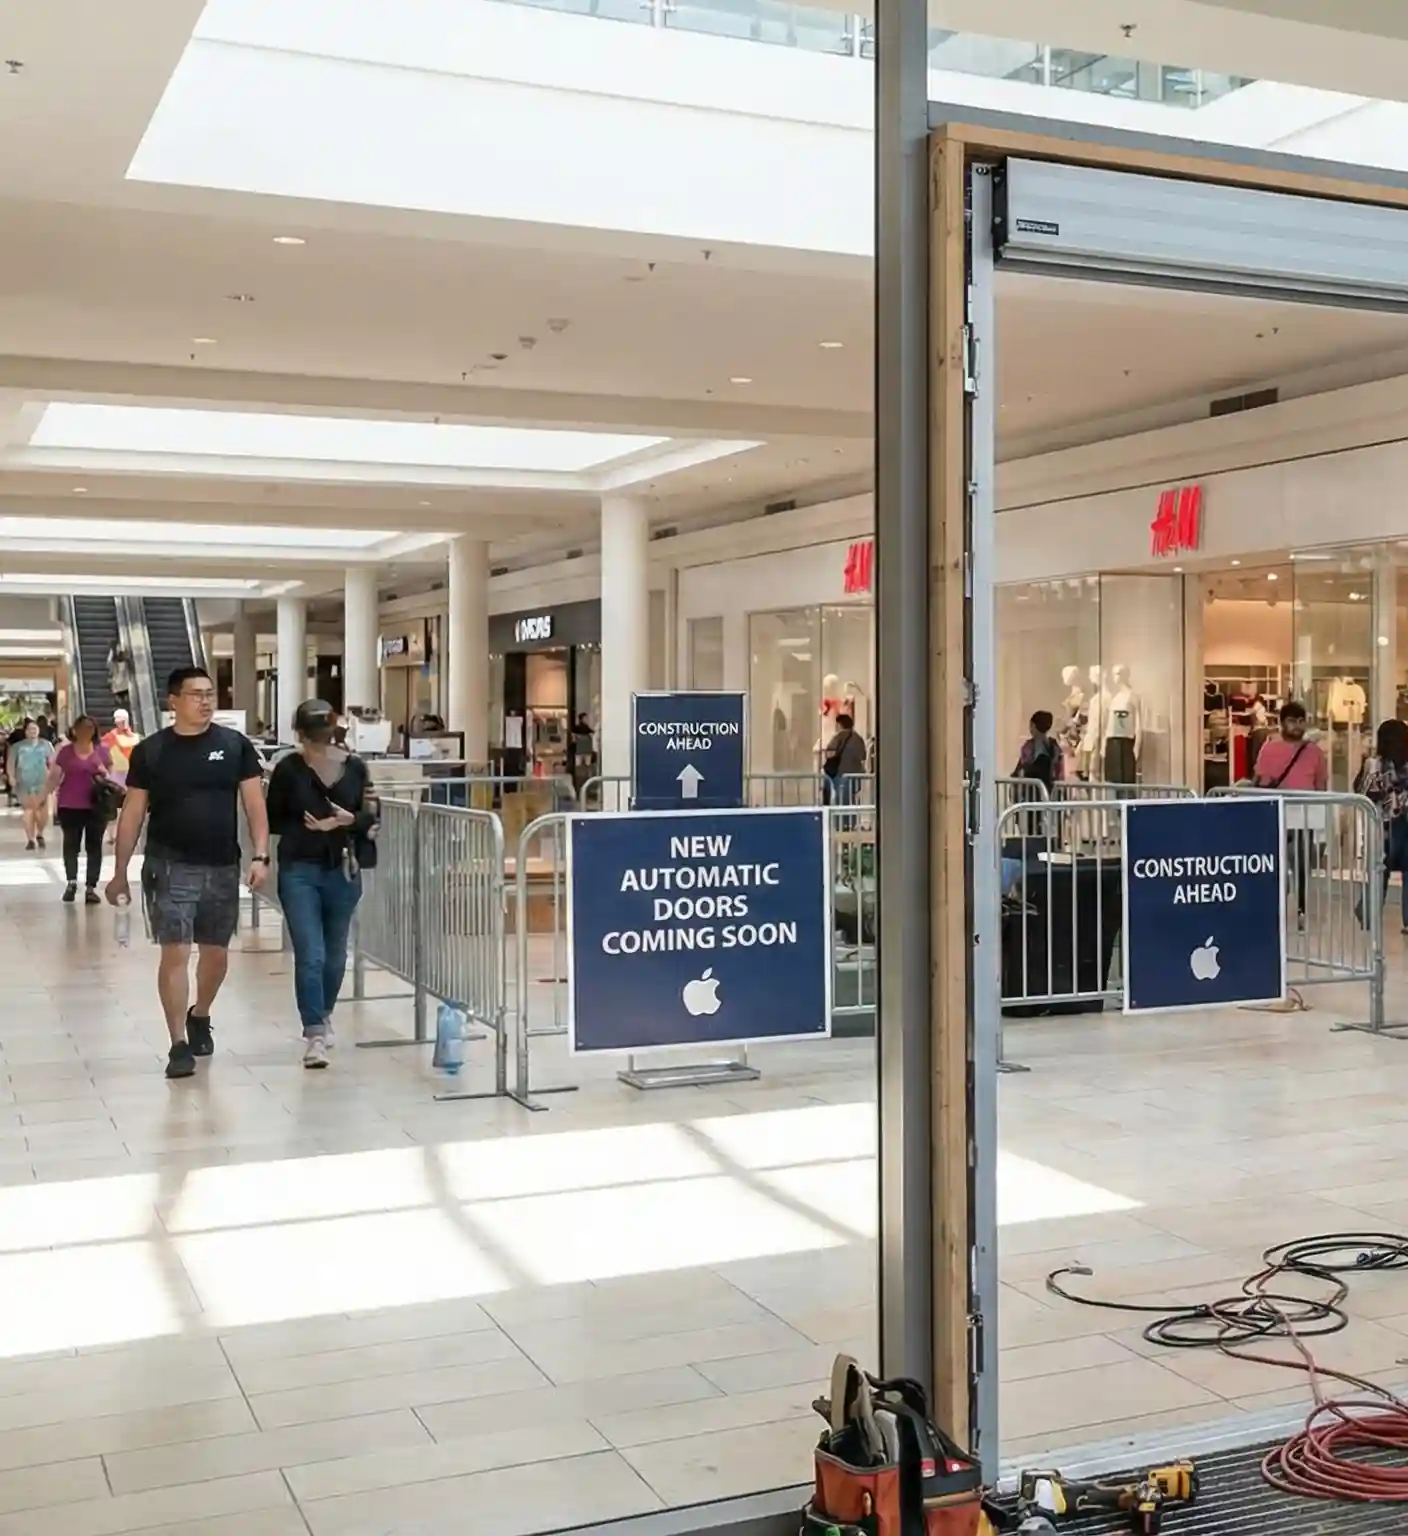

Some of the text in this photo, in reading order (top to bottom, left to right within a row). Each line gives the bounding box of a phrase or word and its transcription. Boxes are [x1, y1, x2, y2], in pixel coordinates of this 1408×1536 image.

[638, 722, 739, 736] CONSTRUCTION
[666, 738, 712, 750] AHEAD
[670, 835, 732, 859] NEW
[620, 863, 780, 892] AUTOMATIC
[1133, 853, 1275, 879] CONSTRUCTION
[1173, 882, 1237, 905] AHEAD
[653, 894, 749, 921] DOORS
[602, 921, 797, 955] COMING SOON
